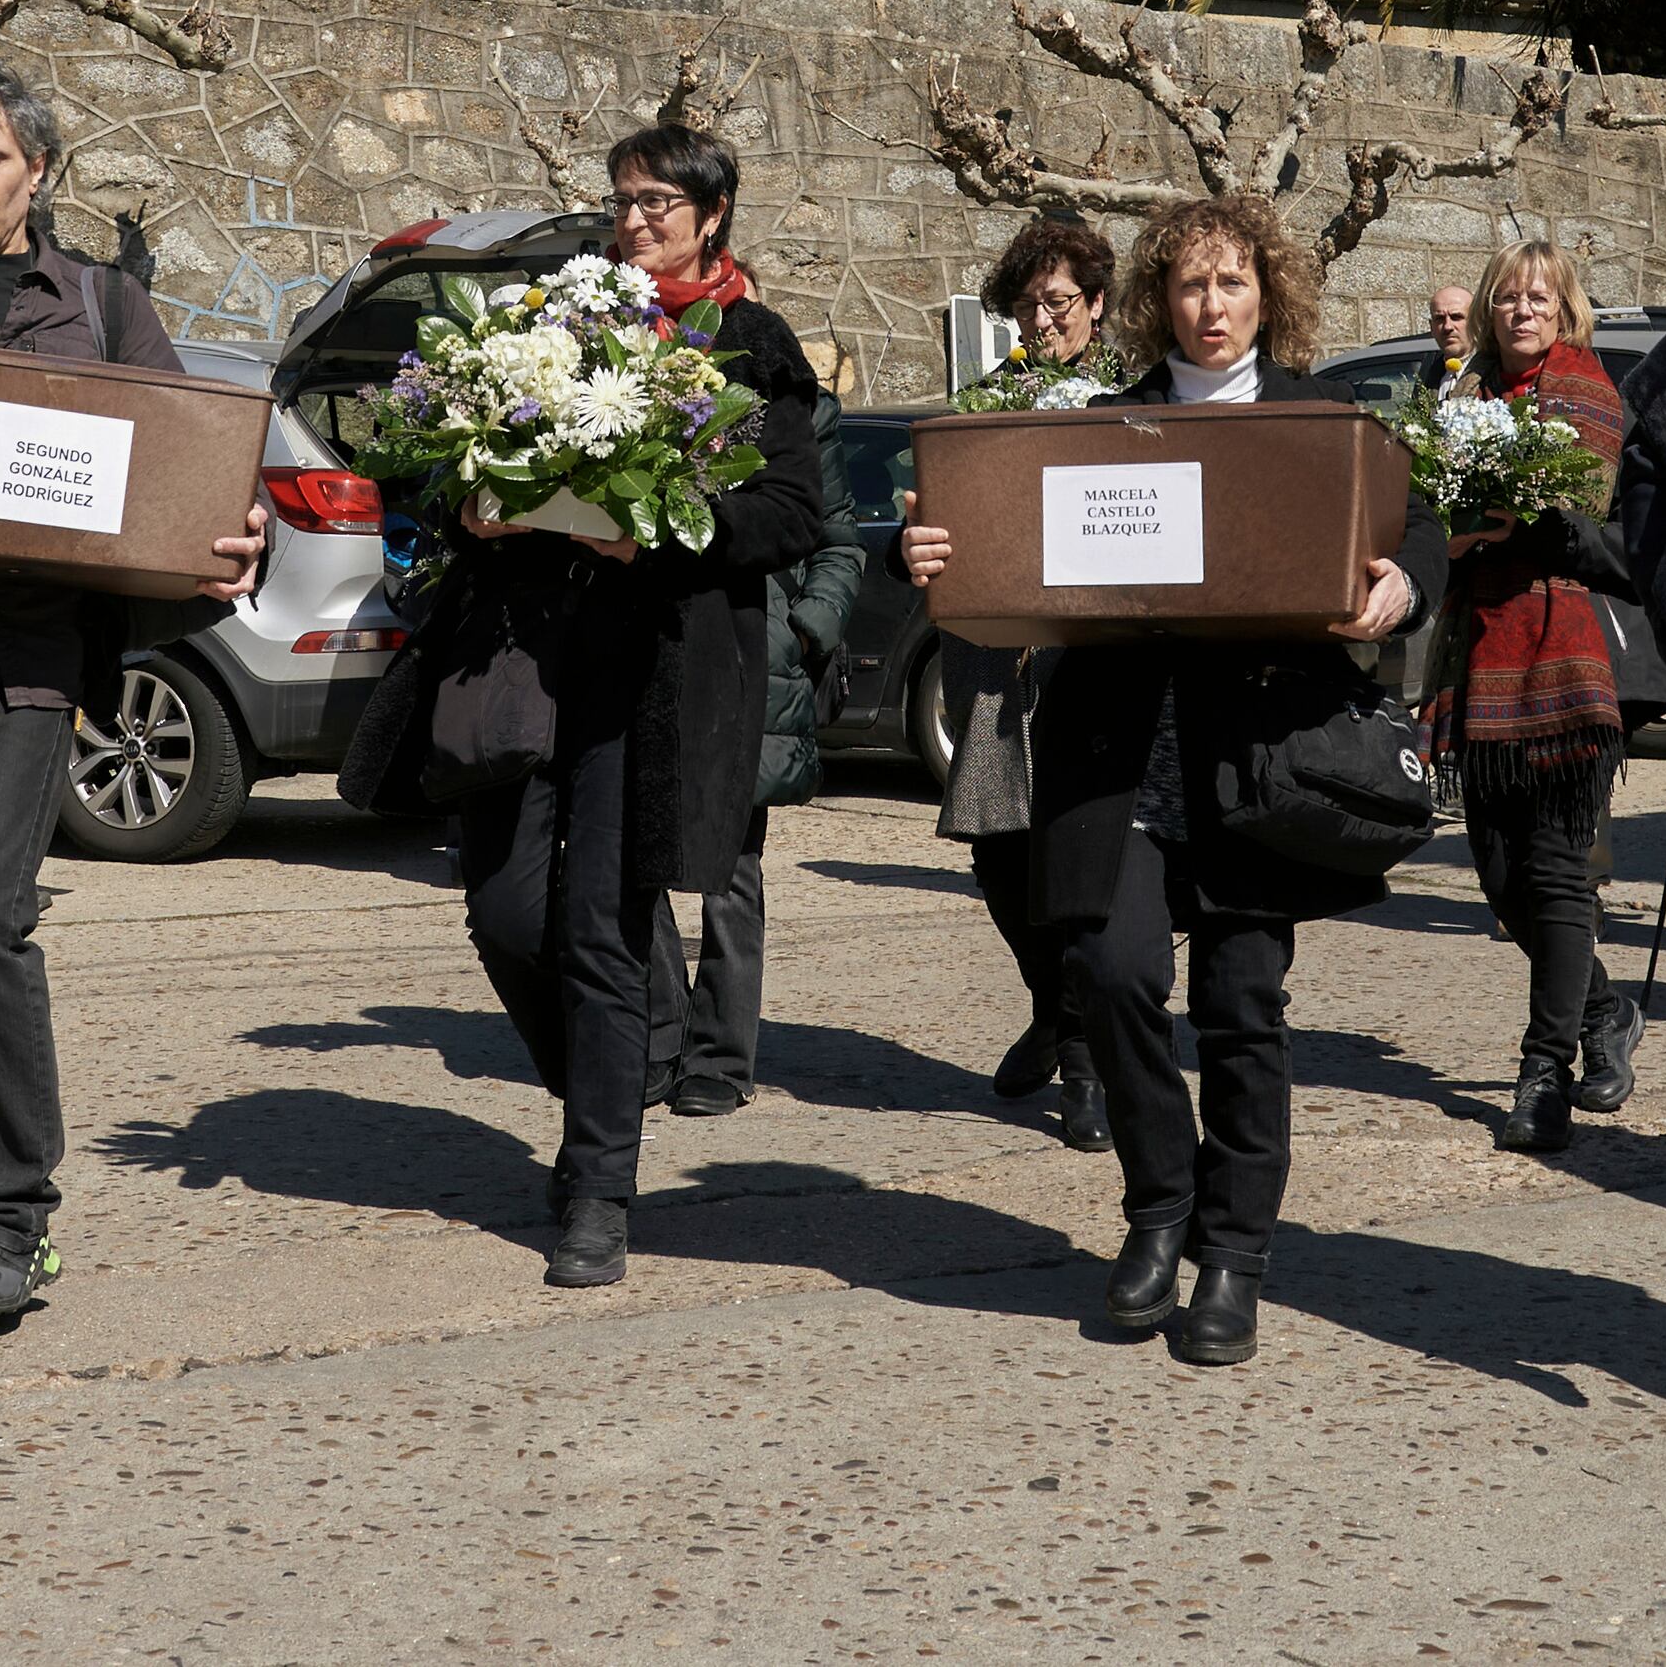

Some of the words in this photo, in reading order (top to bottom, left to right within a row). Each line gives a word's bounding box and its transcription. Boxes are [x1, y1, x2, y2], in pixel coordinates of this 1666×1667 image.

[15, 440, 92, 465] SEGUNDO
[9, 461, 93, 486] GONZÁLEZ
[1, 481, 94, 508] RODRÍGUEZ
[1084, 488, 1158, 501] MARCELA
[1087, 505, 1156, 518] CASTELO
[1081, 522, 1162, 537] BLAZQUEZ
